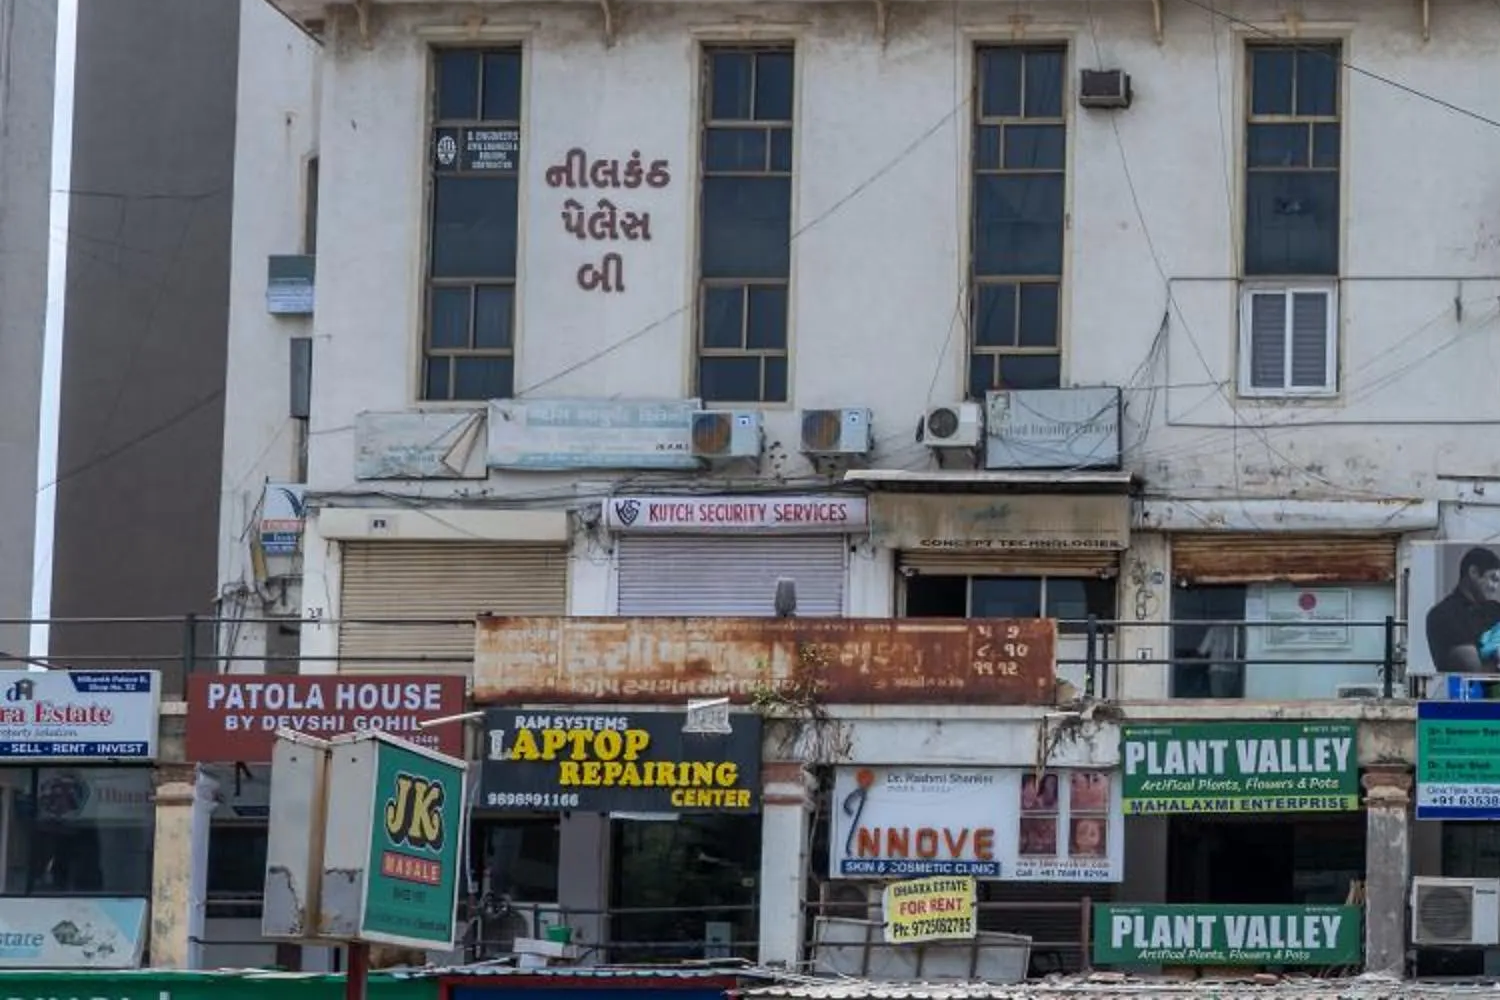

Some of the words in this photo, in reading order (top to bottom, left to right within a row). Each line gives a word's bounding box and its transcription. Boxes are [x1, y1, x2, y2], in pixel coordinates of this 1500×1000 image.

[545, 147, 671, 189] નીલકંઠ
[561, 198, 652, 241] પેલેસ
[576, 251, 626, 293] બી
[649, 503, 694, 522] KUTCH
[699, 503, 766, 522] SECURITY
[774, 503, 848, 522] SERVICES
[207, 682, 324, 711] PATOLA
[335, 682, 442, 711] HOUSE
[34, 700, 114, 725] Estate
[224, 715, 254, 731] BY
[262, 715, 344, 732] DEVSHI
[353, 714, 423, 731] GOHIL
[514, 715, 551, 730] RAM
[553, 715, 629, 731] SYSTEMS
[11, 743, 43, 753] SELL
[52, 743, 87, 753] RENT
[97, 743, 143, 753] INVEST
[489, 728, 651, 762] LAPTOP
[1124, 738, 1229, 776] PLANT
[1235, 737, 1352, 774] VALLEY
[559, 761, 738, 787] REPAIRING
[671, 788, 751, 808] CENTER
[1130, 798, 1235, 813] MAHALAXMI
[1241, 796, 1350, 811] ENTERPRISE
[385, 771, 445, 853] JK
[845, 861, 875, 873] SKIN
[899, 900, 927, 916] FOR
[928, 897, 964, 913] RENT
[1111, 914, 1218, 950] PLANT
[1223, 914, 1343, 949] VALLEY
